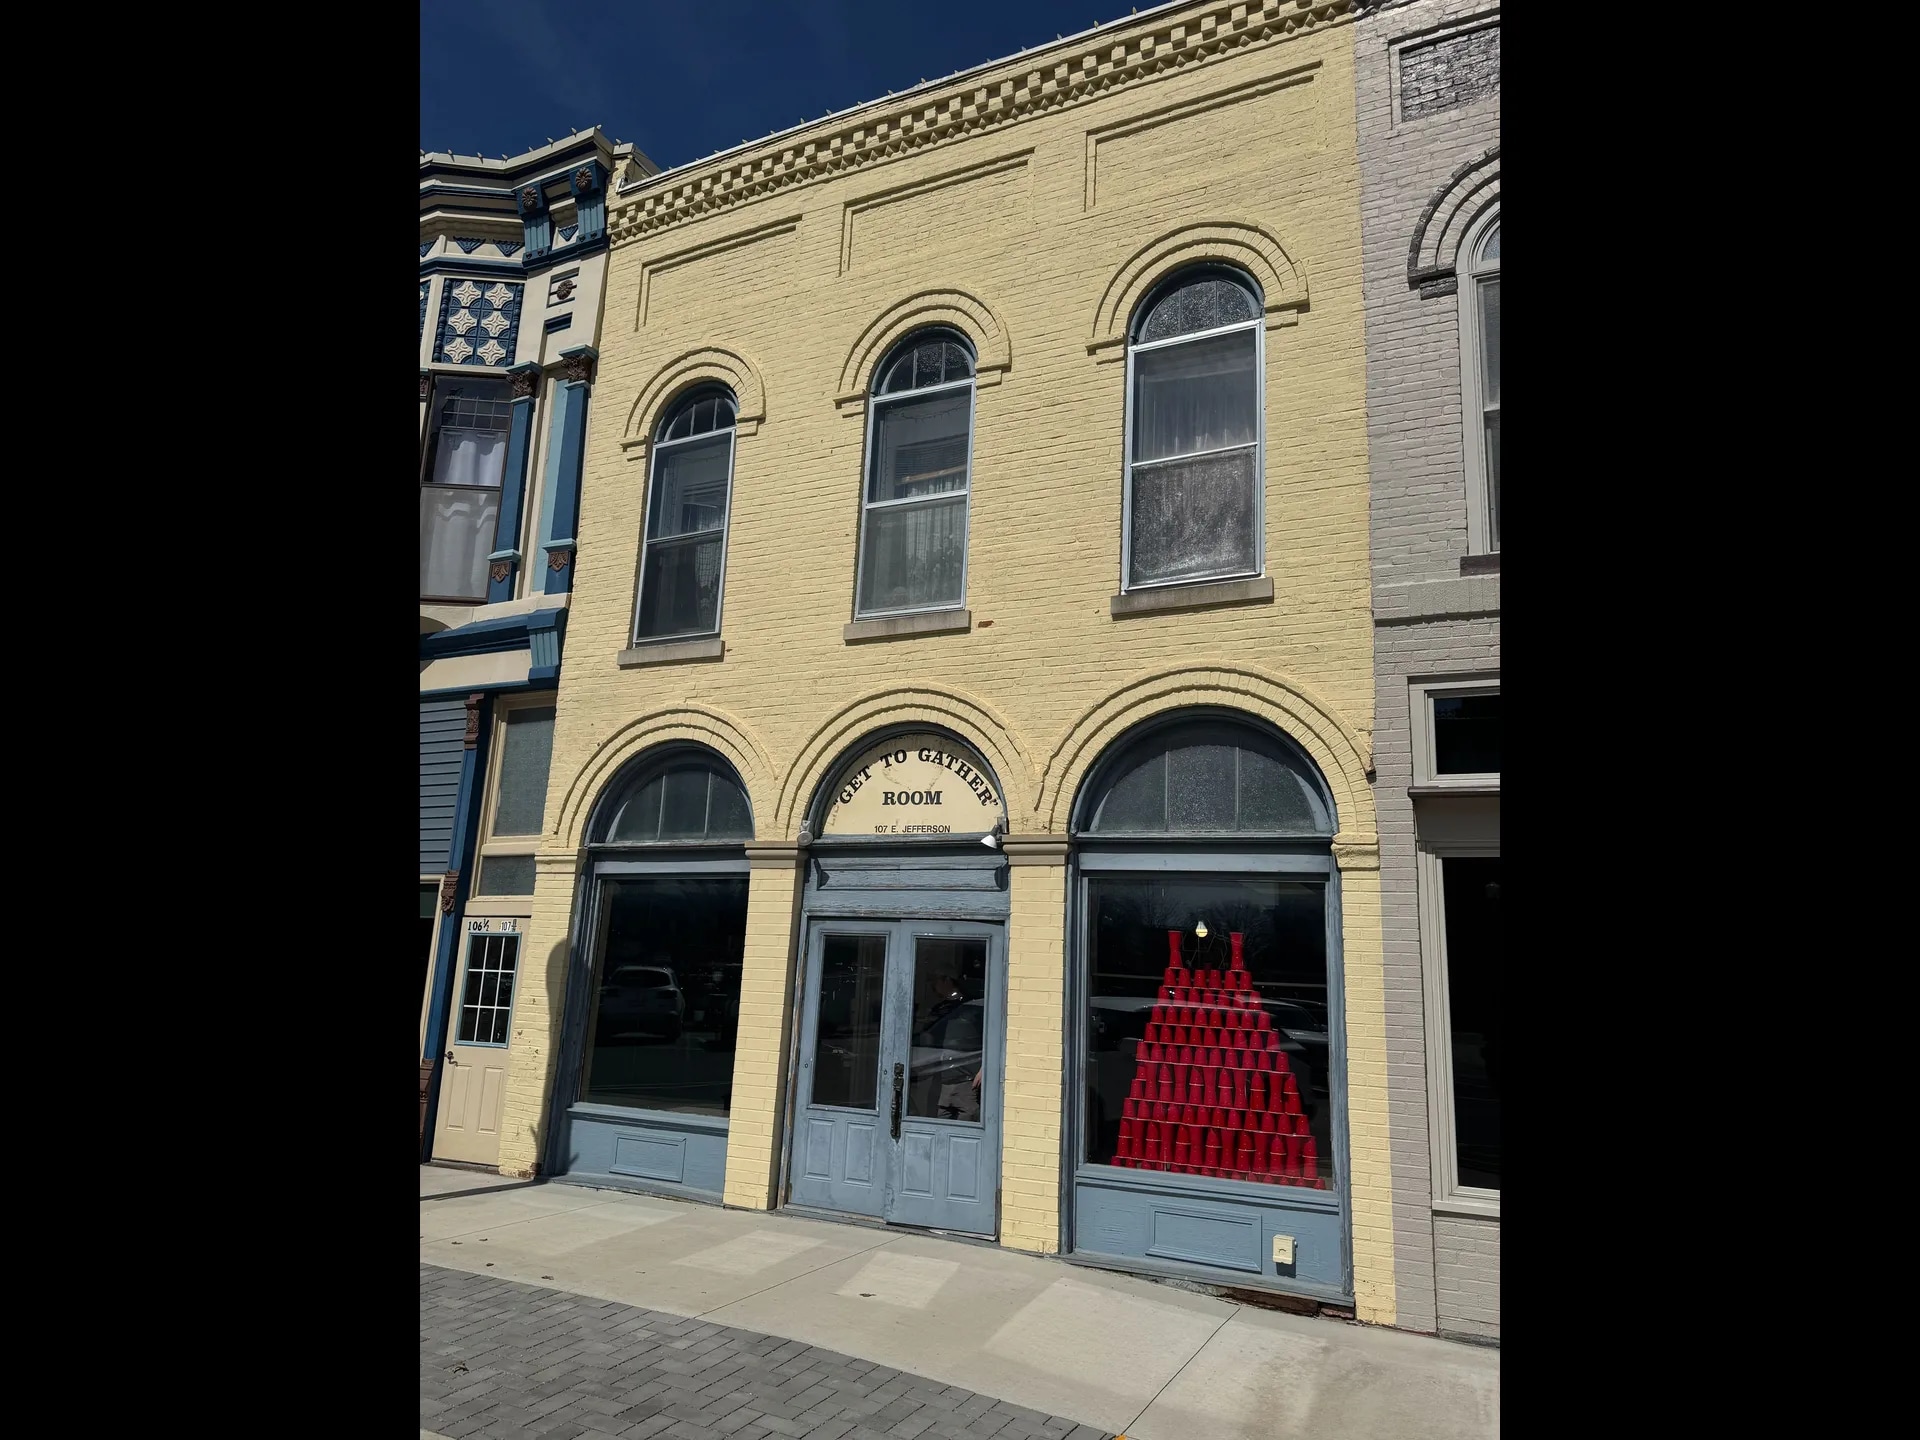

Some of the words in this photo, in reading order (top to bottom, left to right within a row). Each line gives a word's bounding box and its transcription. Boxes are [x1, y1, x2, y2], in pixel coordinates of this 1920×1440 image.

[880, 749, 908, 768] TO
[882, 790, 943, 806] ROOM
[874, 825, 888, 833] 107
[891, 825, 899, 833] E.
[902, 825, 951, 833] JEFFERSON
